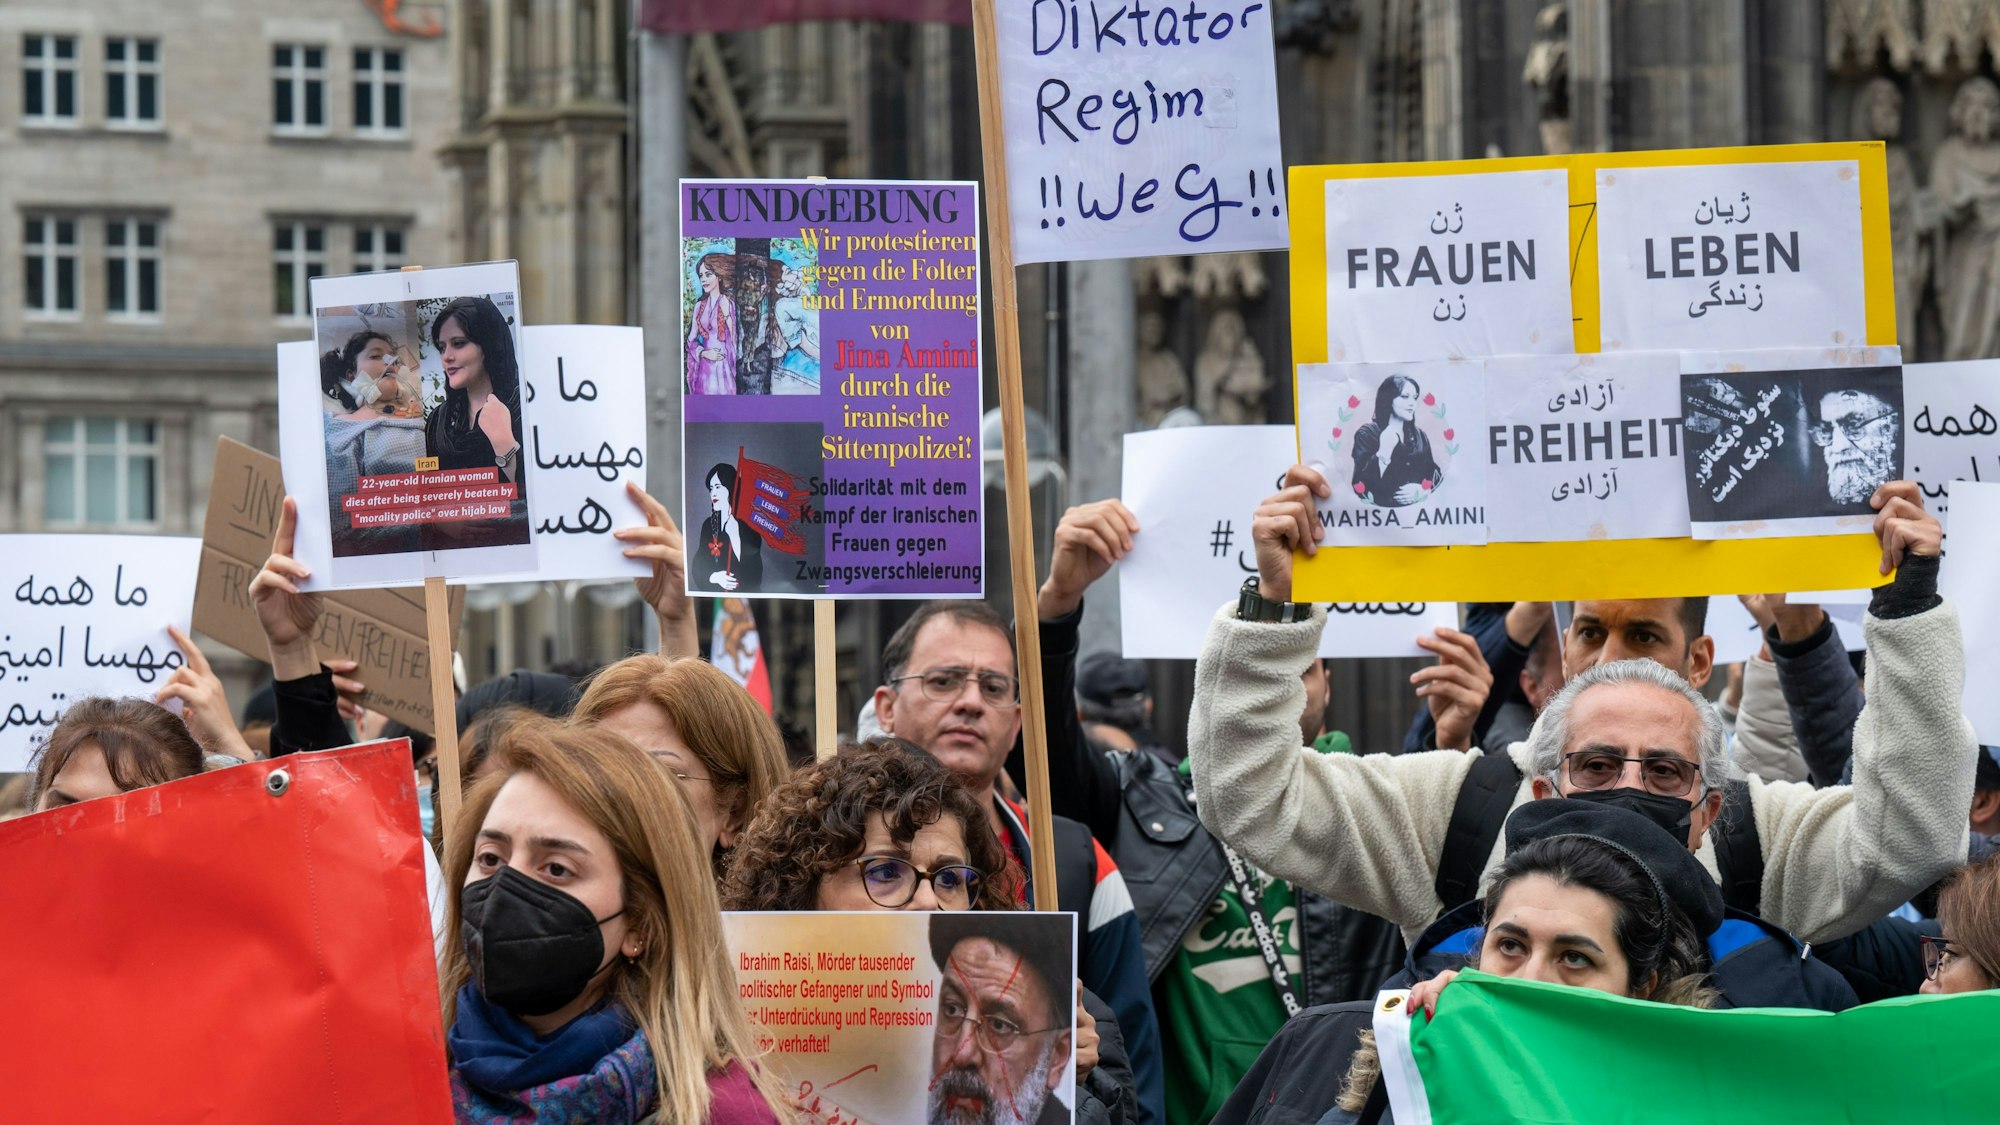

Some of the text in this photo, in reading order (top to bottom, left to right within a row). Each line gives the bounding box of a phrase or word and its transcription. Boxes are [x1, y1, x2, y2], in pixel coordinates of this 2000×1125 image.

[1032, 0, 1262, 55] Diktator
[1037, 78, 1204, 145] Regim
[689, 188, 959, 224] KUNDGEBUNG
[1430, 202, 1464, 235] ژن
[1694, 191, 1751, 225] ژیان
[800, 228, 977, 258] Wir protestieren
[1645, 231, 1801, 280] LEBEN
[801, 258, 976, 288] gegen die Folter
[1347, 239, 1537, 289] FRAUEN
[801, 288, 978, 317] und Ermordung
[1433, 296, 1467, 322] زن
[1688, 282, 1764, 319] زندگی
[870, 323, 911, 340] von
[834, 339, 977, 371] Jina Amini
[556, 356, 598, 402] ما
[840, 372, 951, 397] durch die
[1548, 377, 1614, 413] آزادی
[843, 404, 950, 428] iranische
[1913, 404, 1998, 436] همه
[533, 424, 643, 482] مهسا
[821, 435, 972, 467] Sittenpolizei!
[1489, 417, 1683, 465] FREIHEIT
[417, 459, 437, 469] Iran
[361, 471, 494, 490] 22-year-old Iranian woman
[761, 482, 784, 498] FRAUEN
[810, 476, 967, 497] Solidarität mit dem
[1551, 467, 1619, 502] آزادی
[1711, 464, 1743, 503] است
[345, 486, 514, 507] dies after being severely beaten by
[437, 509, 459, 518] over
[461, 504, 486, 517] hijab
[488, 503, 506, 514] law
[761, 499, 780, 515] LEBEN
[753, 514, 779, 534] FREIHEIT
[800, 506, 978, 528] Kampf der iranischen
[831, 532, 947, 558] Frauen gegen
[15, 564, 148, 607] ما همه
[796, 561, 982, 585] Zwangsverschleierung
[84, 626, 184, 683] مهسا
[1250, 911, 1278, 964] adidas
[740, 952, 915, 974] Ibrahim Raisi, Mörder tausender
[739, 979, 933, 1004] politischer Gefangener und Symbol
[760, 1007, 842, 1031] Unterdrückung
[845, 1007, 867, 1026] und
[869, 1007, 933, 1031] Repression
[778, 1034, 830, 1053] verhaftet!
